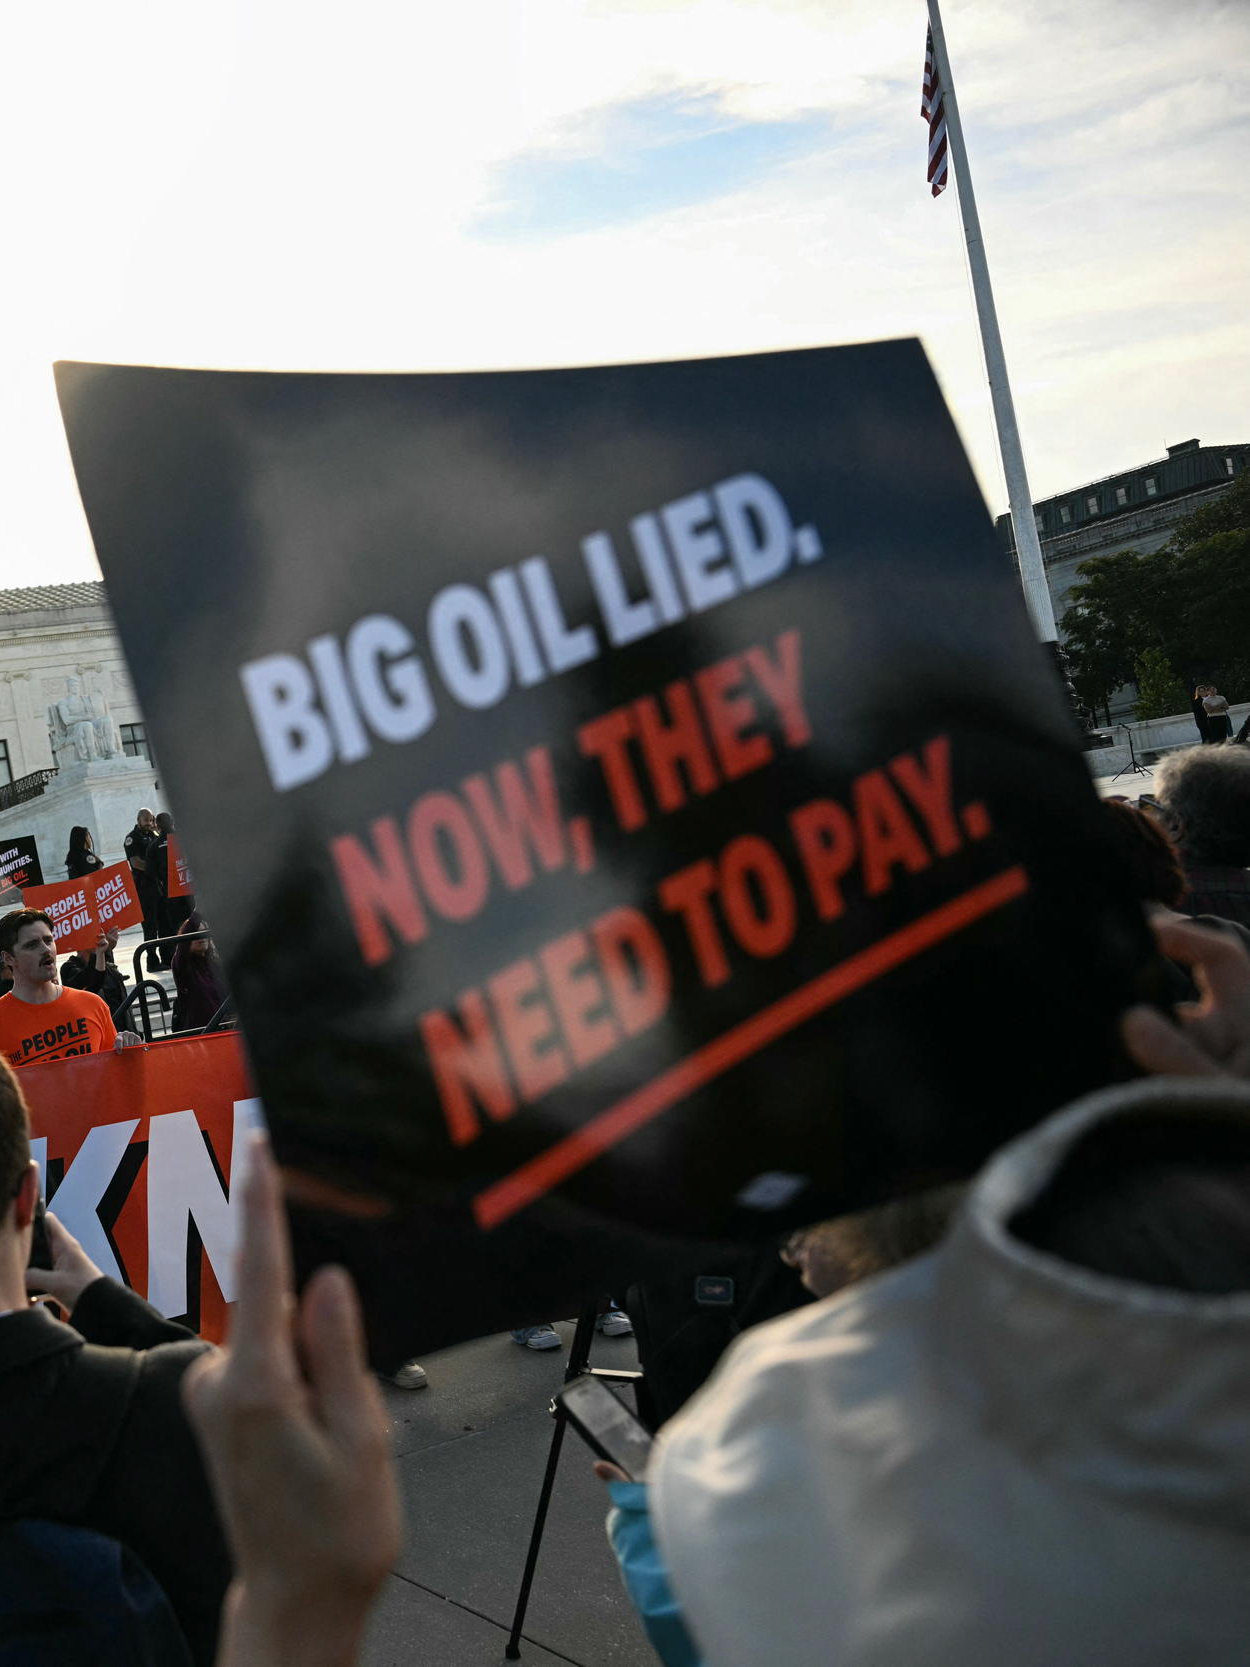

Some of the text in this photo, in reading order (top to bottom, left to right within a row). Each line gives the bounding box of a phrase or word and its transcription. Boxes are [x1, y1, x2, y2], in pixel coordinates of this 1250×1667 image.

[240, 471, 824, 793] BIG OIL LIED.
[331, 629, 814, 968] NOW, THEY
[0, 847, 19, 863] WITH
[1, 875, 13, 888] BIG
[95, 874, 124, 903] OPLE
[44, 889, 86, 918] PEOPLE
[98, 892, 132, 923] IG OIL
[52, 910, 93, 941] BIG OIL
[420, 736, 992, 1149] NEED TO PAY.
[9, 1017, 88, 1065] THE PEOPLE
[29, 1097, 262, 1320] KN
